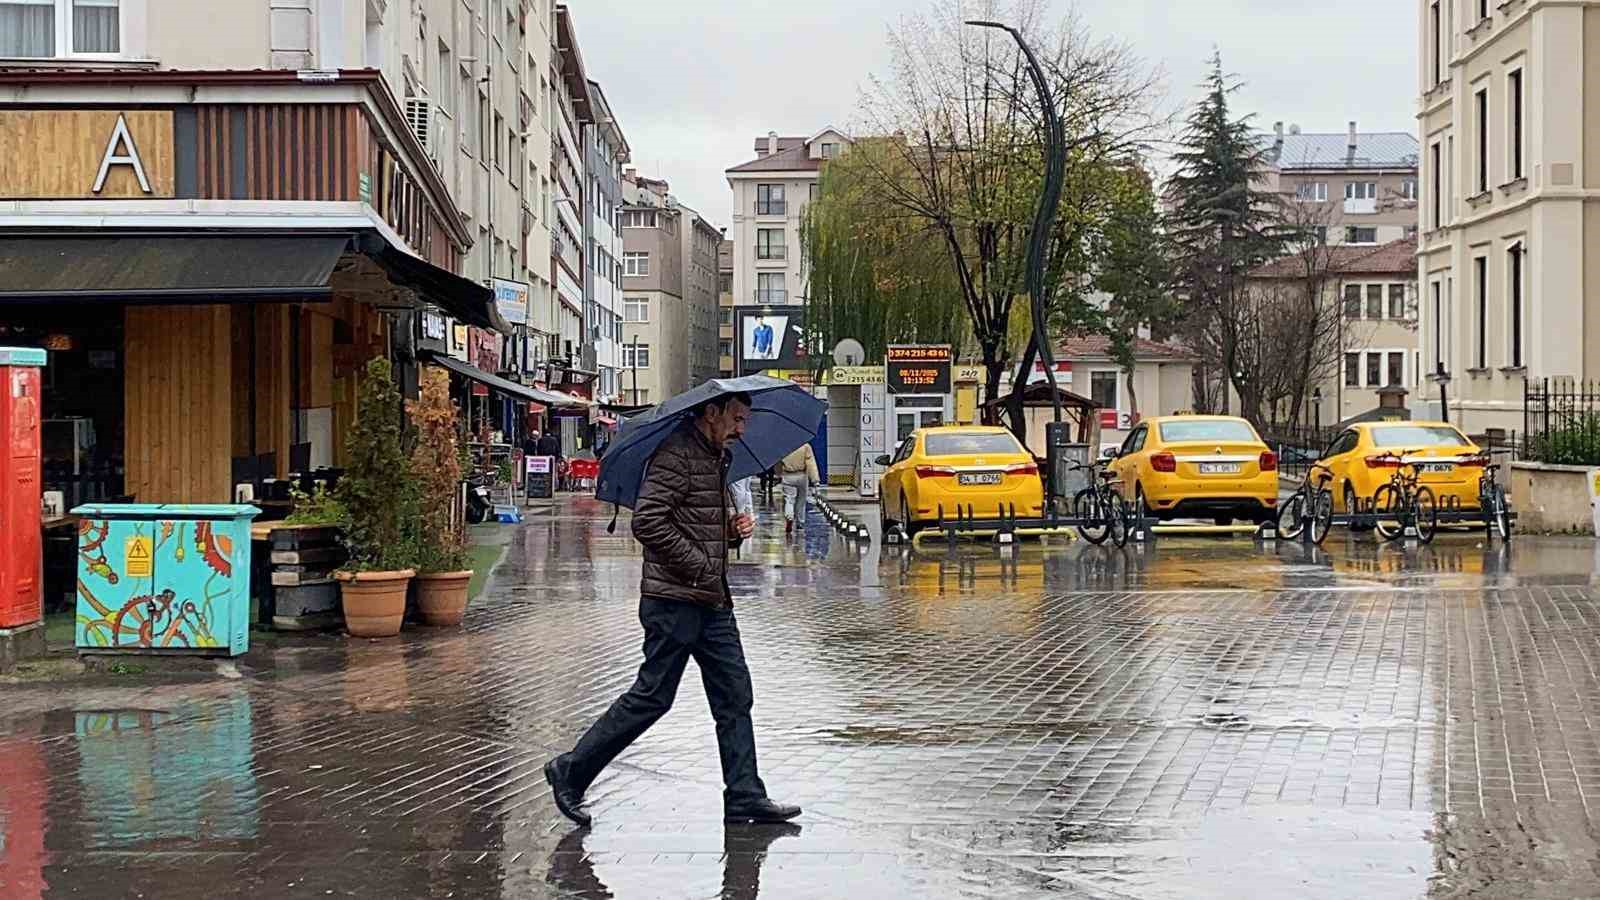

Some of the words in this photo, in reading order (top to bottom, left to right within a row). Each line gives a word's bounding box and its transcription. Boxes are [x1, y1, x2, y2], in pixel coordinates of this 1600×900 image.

[92, 112, 152, 193] A
[911, 349, 926, 358] 215
[862, 392, 873, 490] KONAK
